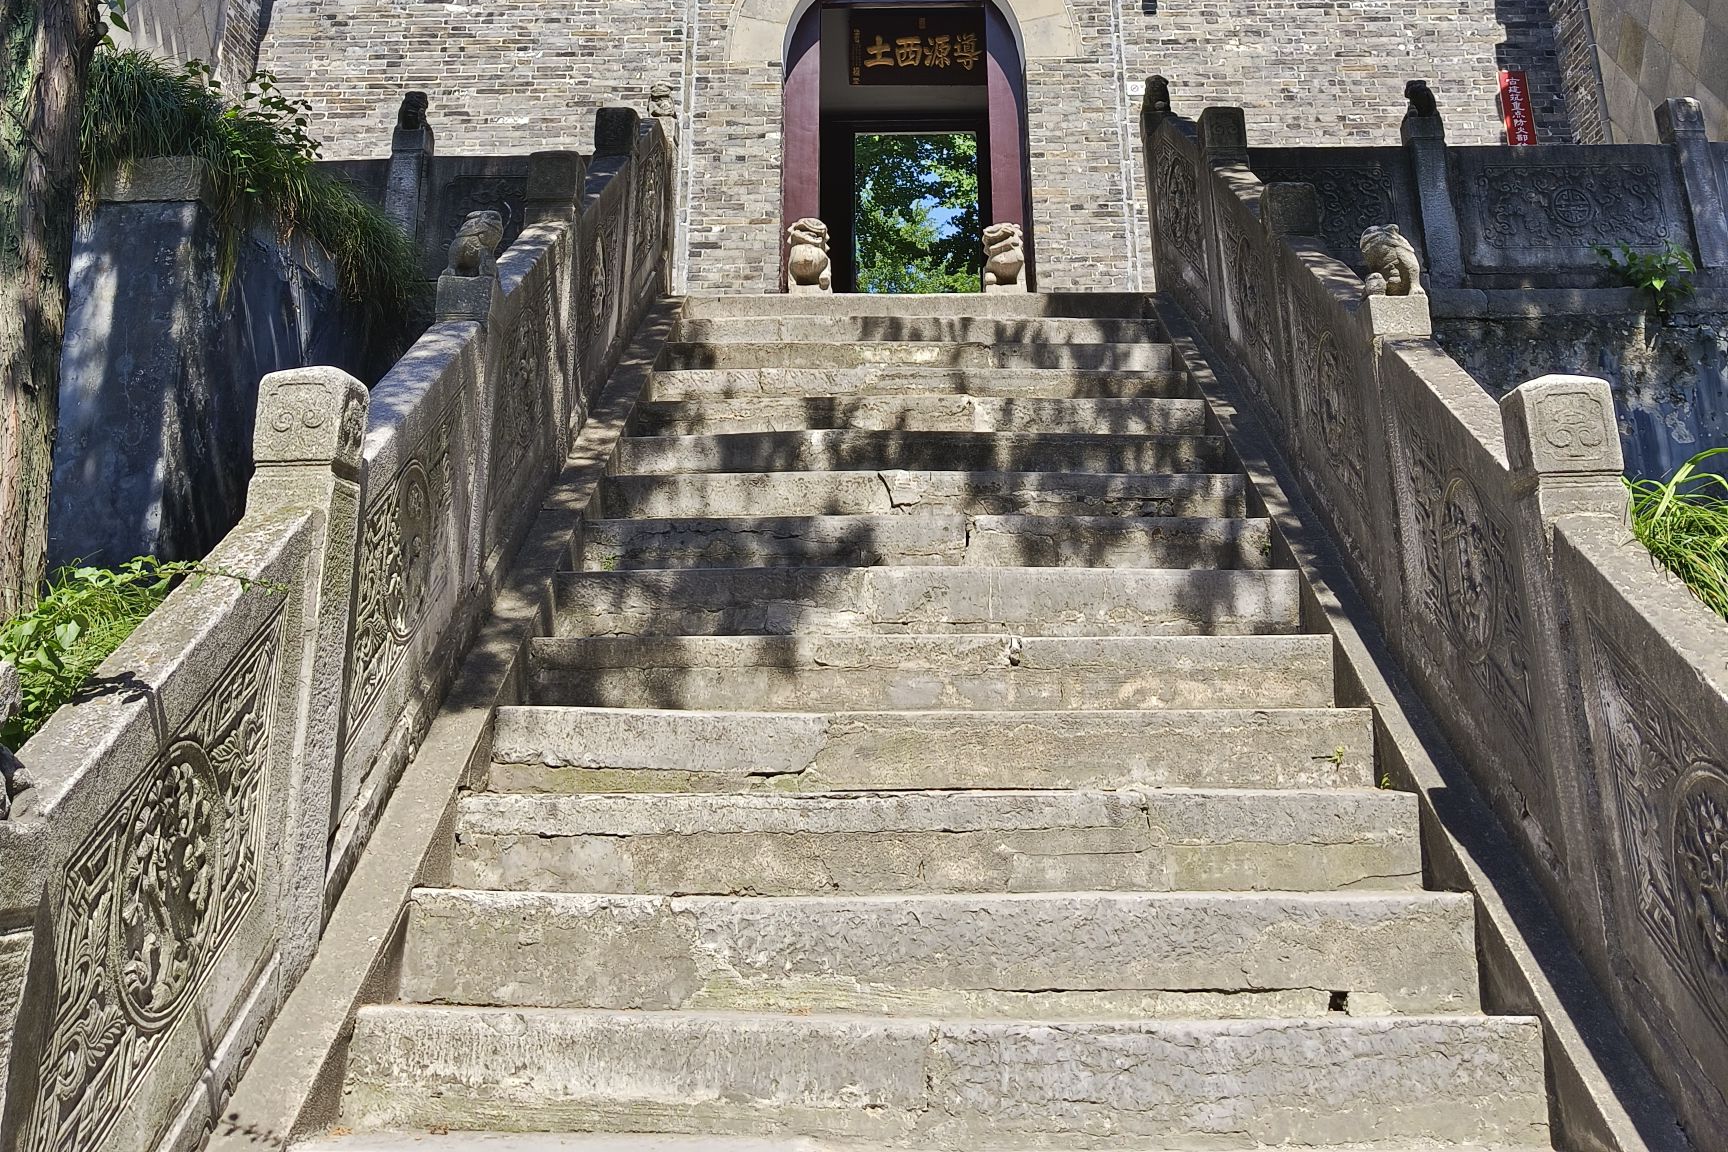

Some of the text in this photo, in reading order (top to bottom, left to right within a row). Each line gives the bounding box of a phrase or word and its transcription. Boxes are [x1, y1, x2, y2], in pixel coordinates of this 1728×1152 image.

[1505, 76, 1530, 146] 古建筑重点防火部
